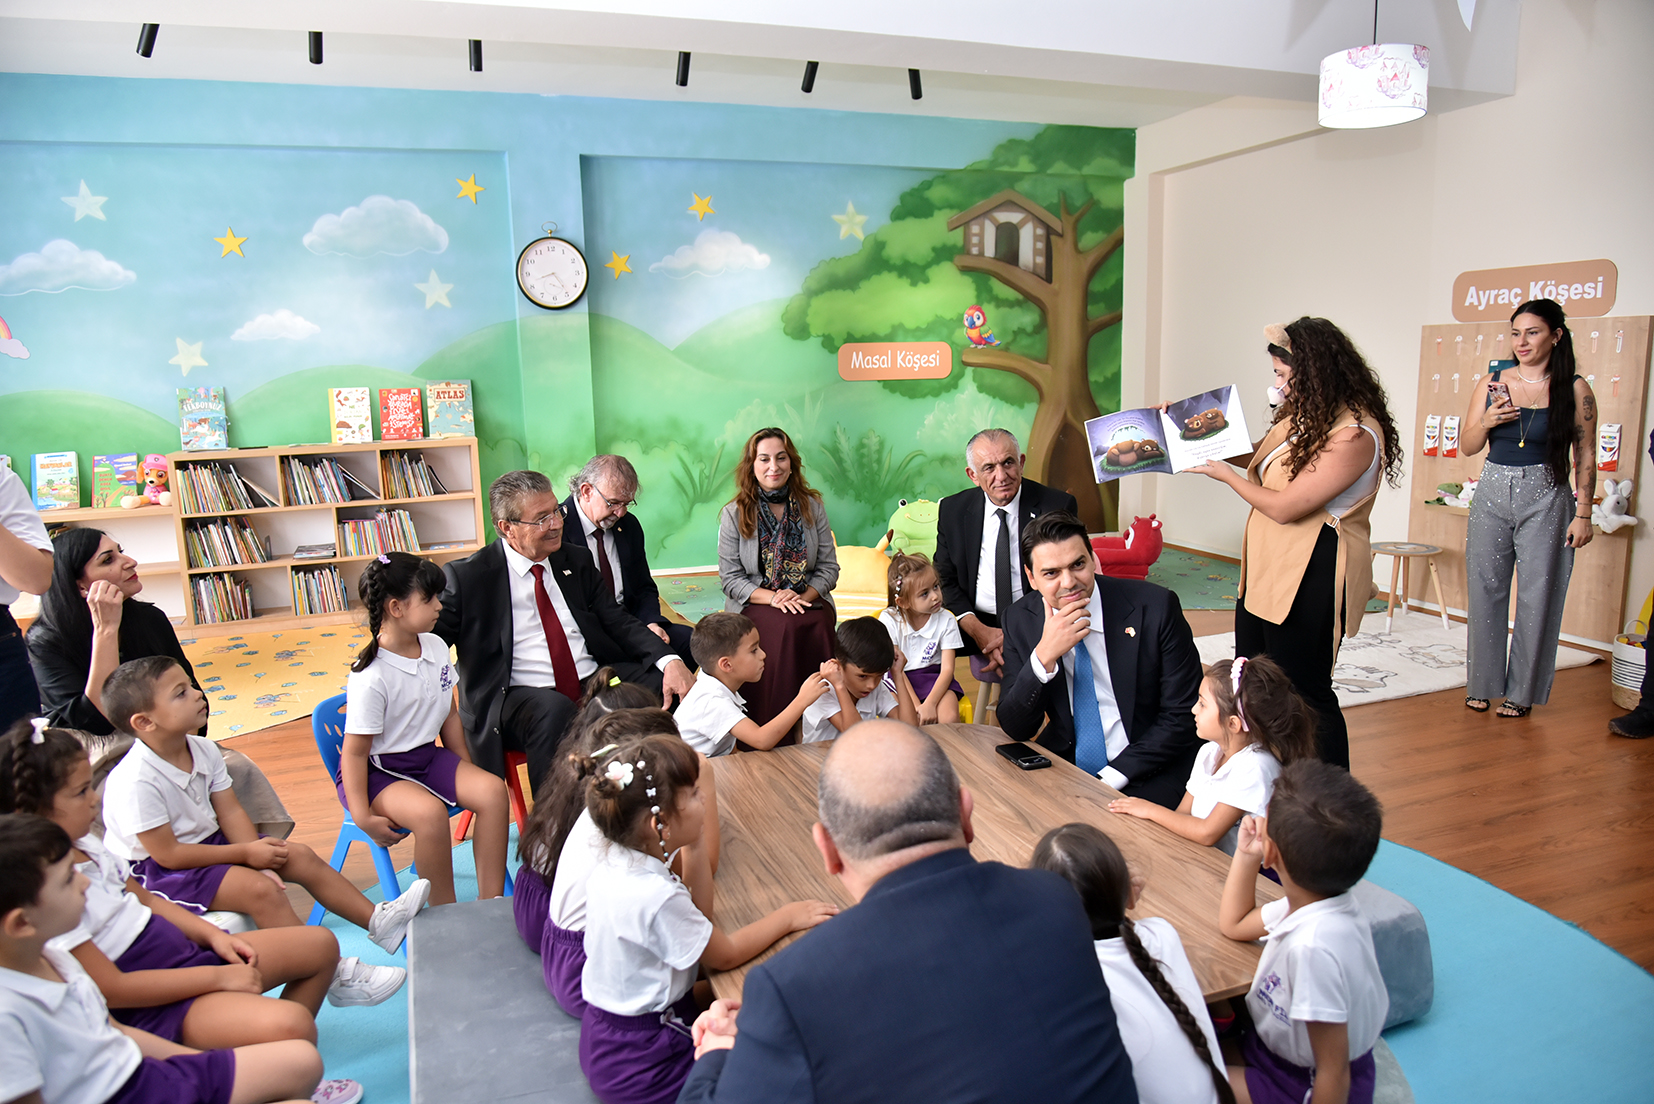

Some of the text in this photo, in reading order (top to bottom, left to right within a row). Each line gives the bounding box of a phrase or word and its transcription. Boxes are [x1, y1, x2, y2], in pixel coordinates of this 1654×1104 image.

[1464, 276, 1604, 310] Ayraç Köşesi
[851, 350, 940, 371] Masal Köşesi
[435, 390, 465, 399] ATLAS
